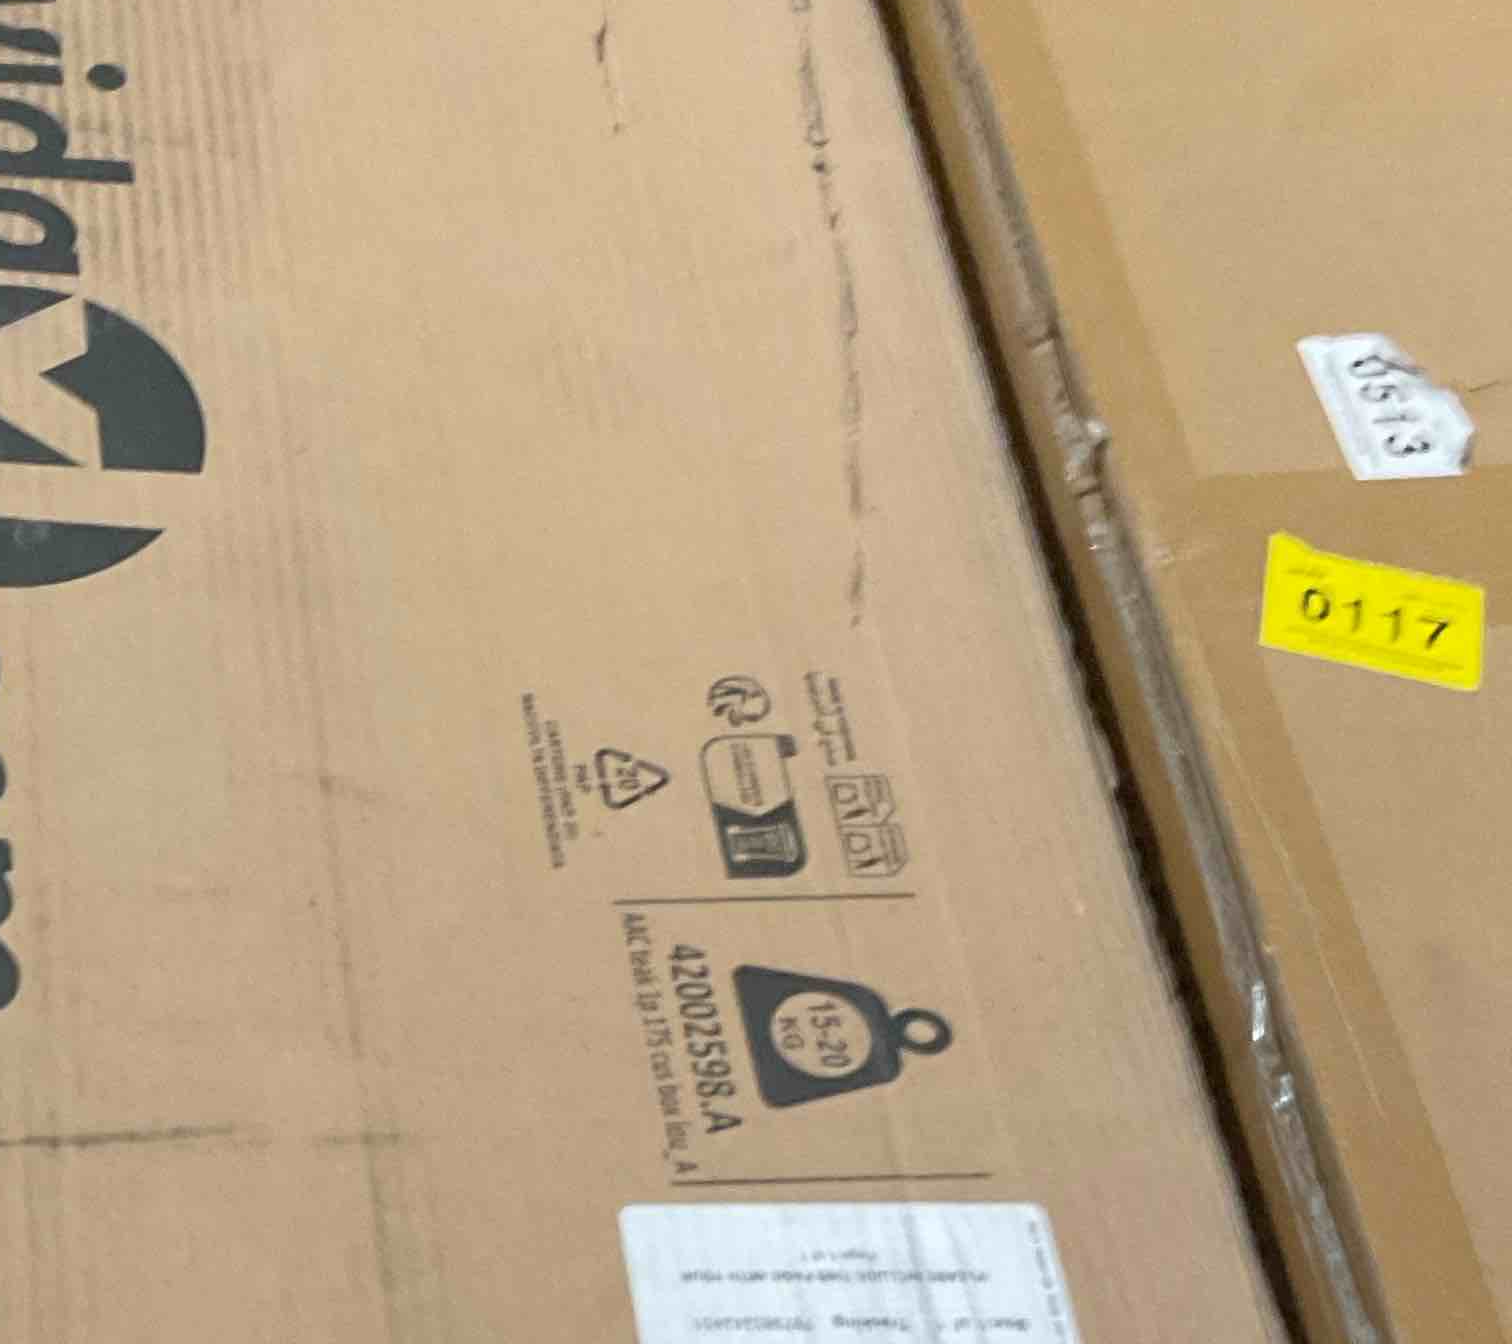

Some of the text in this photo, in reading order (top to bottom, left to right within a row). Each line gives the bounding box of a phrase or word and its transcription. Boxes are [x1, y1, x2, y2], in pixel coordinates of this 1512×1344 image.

[1300, 587, 1450, 649] 0117
[667, 944, 743, 1135] 42002598.A
[777, 1015, 802, 1051] KG
[806, 1000, 852, 1068] 15-20
